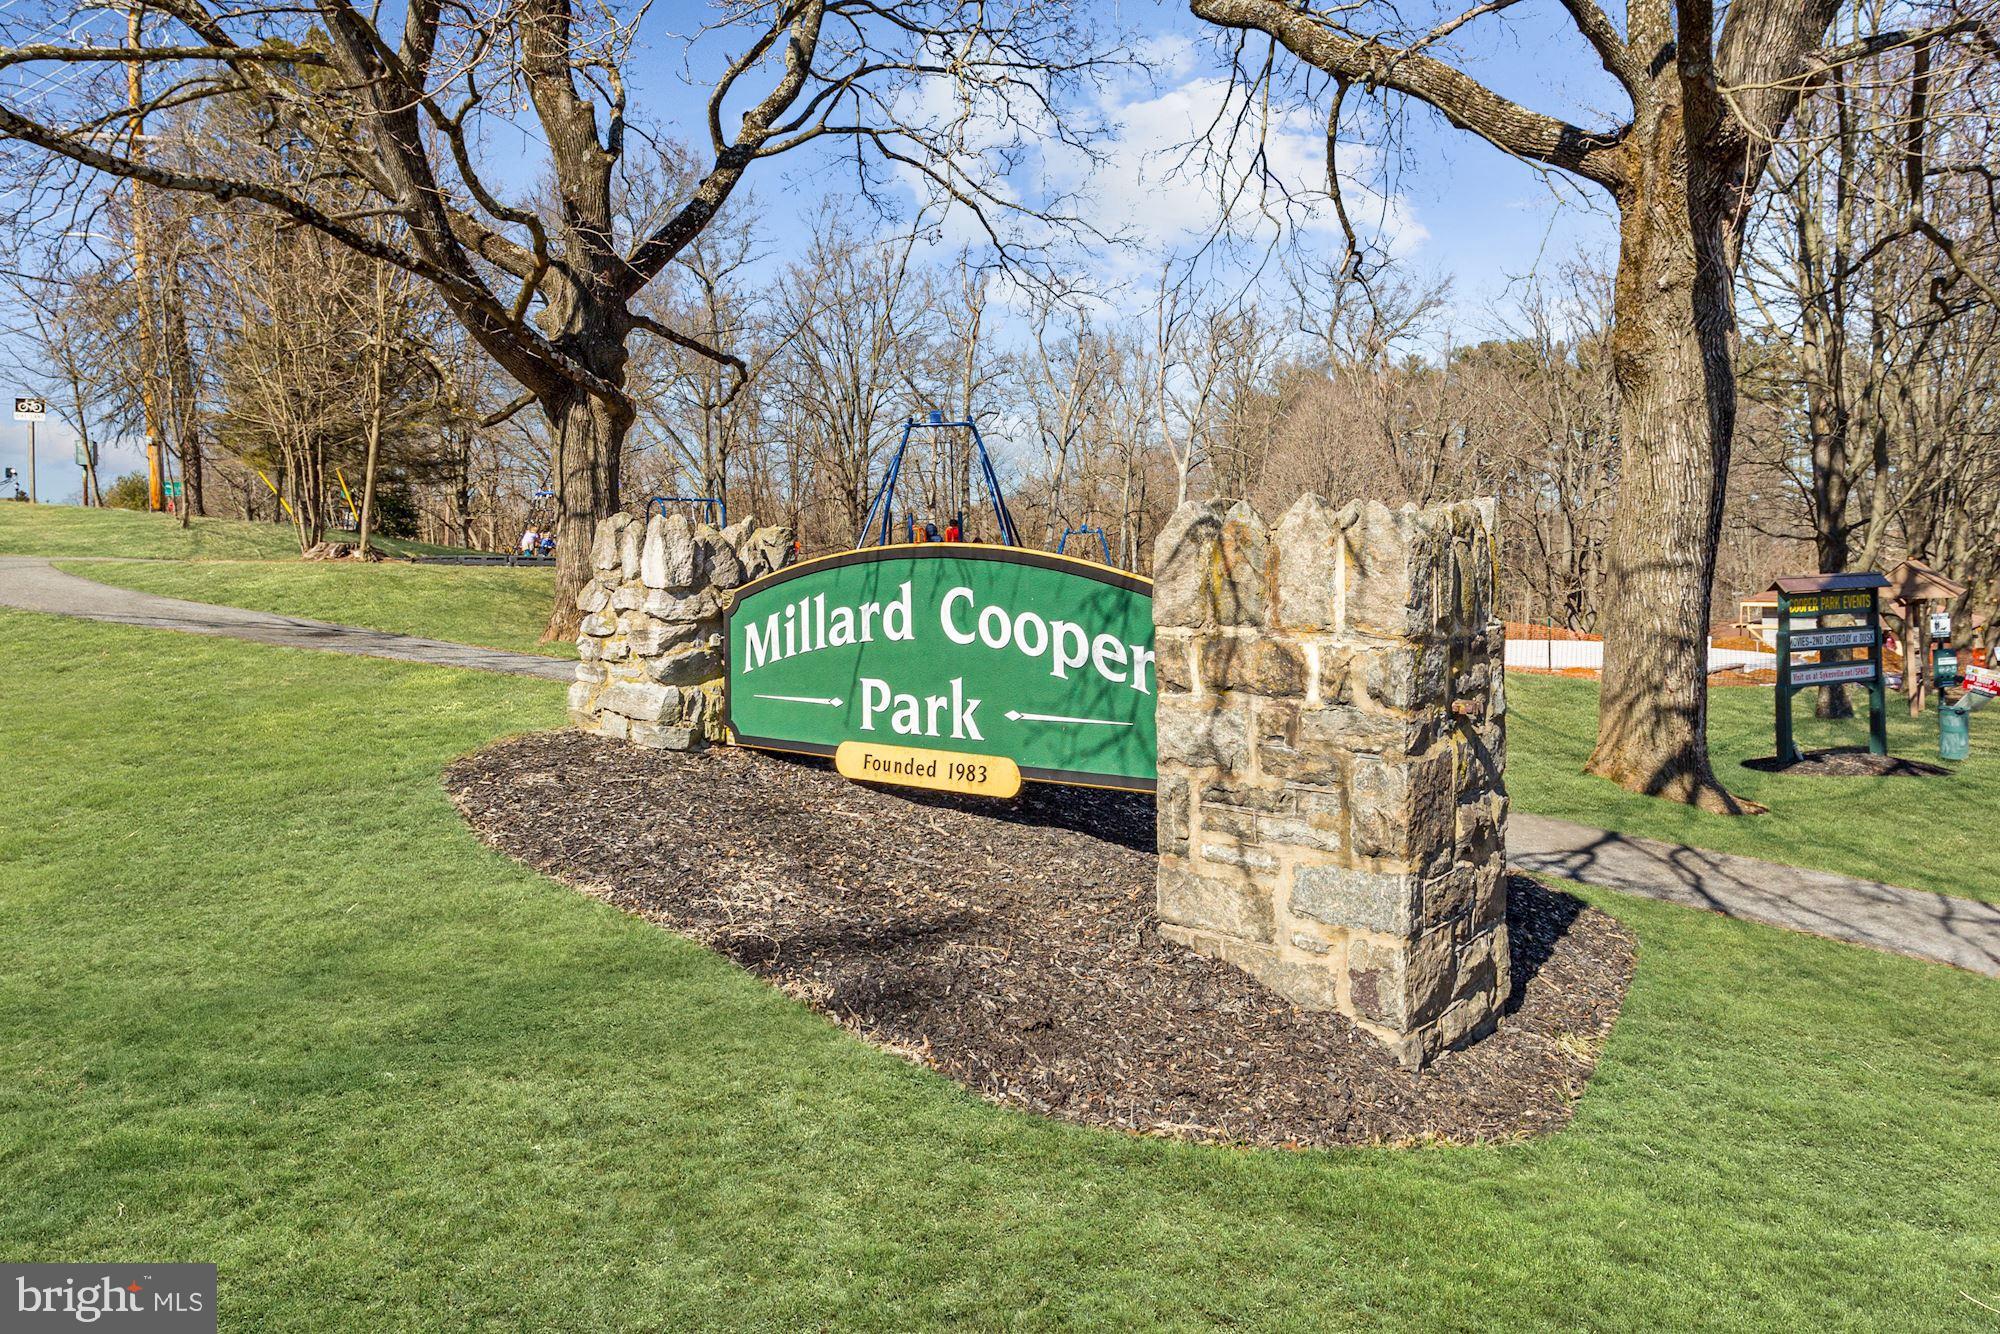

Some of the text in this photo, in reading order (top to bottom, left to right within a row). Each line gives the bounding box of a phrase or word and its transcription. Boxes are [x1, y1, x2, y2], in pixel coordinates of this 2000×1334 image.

[1789, 594, 1871, 613] COOPER PARK EVENTS
[742, 580, 1155, 695] Millard Cooper
[1826, 634, 1851, 645] SATURDAY
[1859, 633, 1874, 642] DUSK
[1792, 673, 1804, 681] Visit
[1813, 672, 1818, 680] at
[859, 677, 985, 741] Park
[863, 753, 988, 783] Founded 1983
